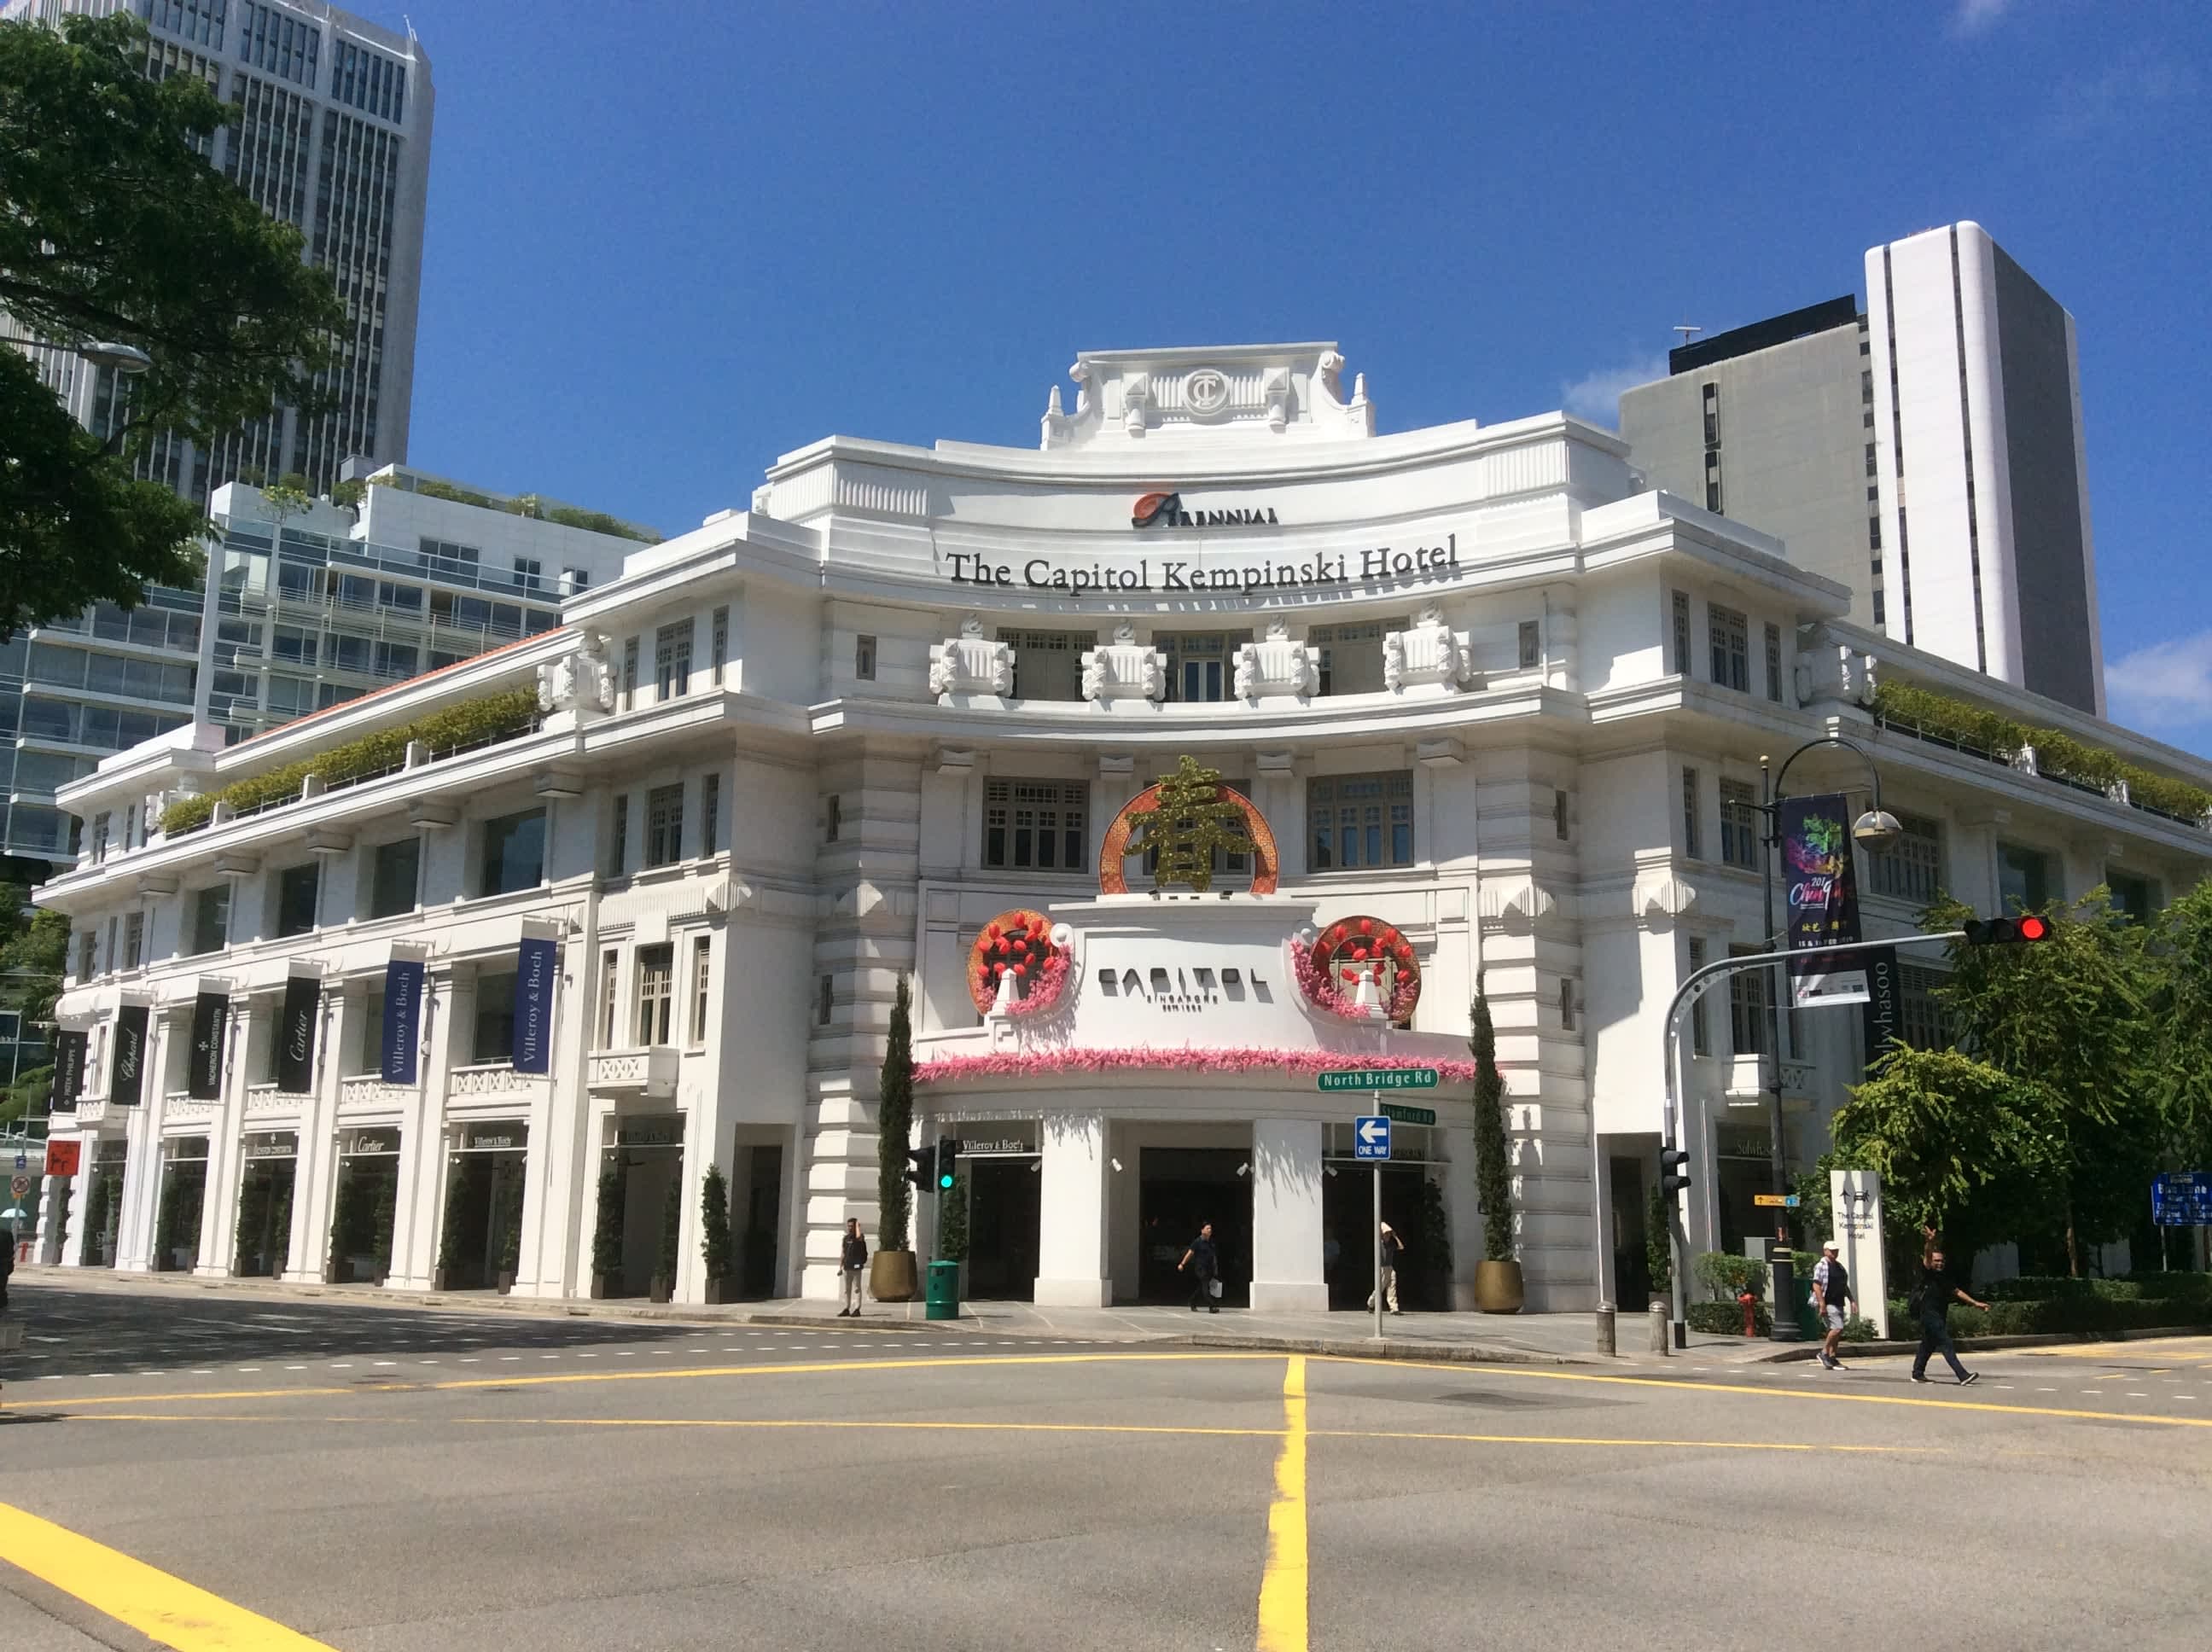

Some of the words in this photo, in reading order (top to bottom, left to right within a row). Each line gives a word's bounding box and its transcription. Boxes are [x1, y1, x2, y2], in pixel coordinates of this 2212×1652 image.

[946, 553, 1012, 585] The
[1024, 559, 1150, 596] Capitol
[1161, 552, 1349, 596] Kempinski
[1360, 533, 1458, 579] Hotel
[527, 951, 543, 989] Boch
[1097, 967, 1272, 996] CAPITOL
[395, 972, 410, 1007] Boch
[528, 992, 539, 1002] &
[396, 1009, 406, 1019] &
[289, 1010, 307, 1062] Cartier
[392, 1023, 408, 1075] Villeroy
[523, 1006, 540, 1062] Villeroy
[121, 1027, 139, 1081] Chopard
[1324, 1073, 1361, 1086] North
[1366, 1073, 1410, 1087] Bridge
[1415, 1071, 1431, 1084] Rd
[358, 1136, 385, 1153] Cartier
[963, 1140, 994, 1151] Villeroy
[1002, 1139, 1024, 1149] Boch
[1358, 1145, 1372, 1155] ONE
[1374, 1145, 1388, 1155] WAY
